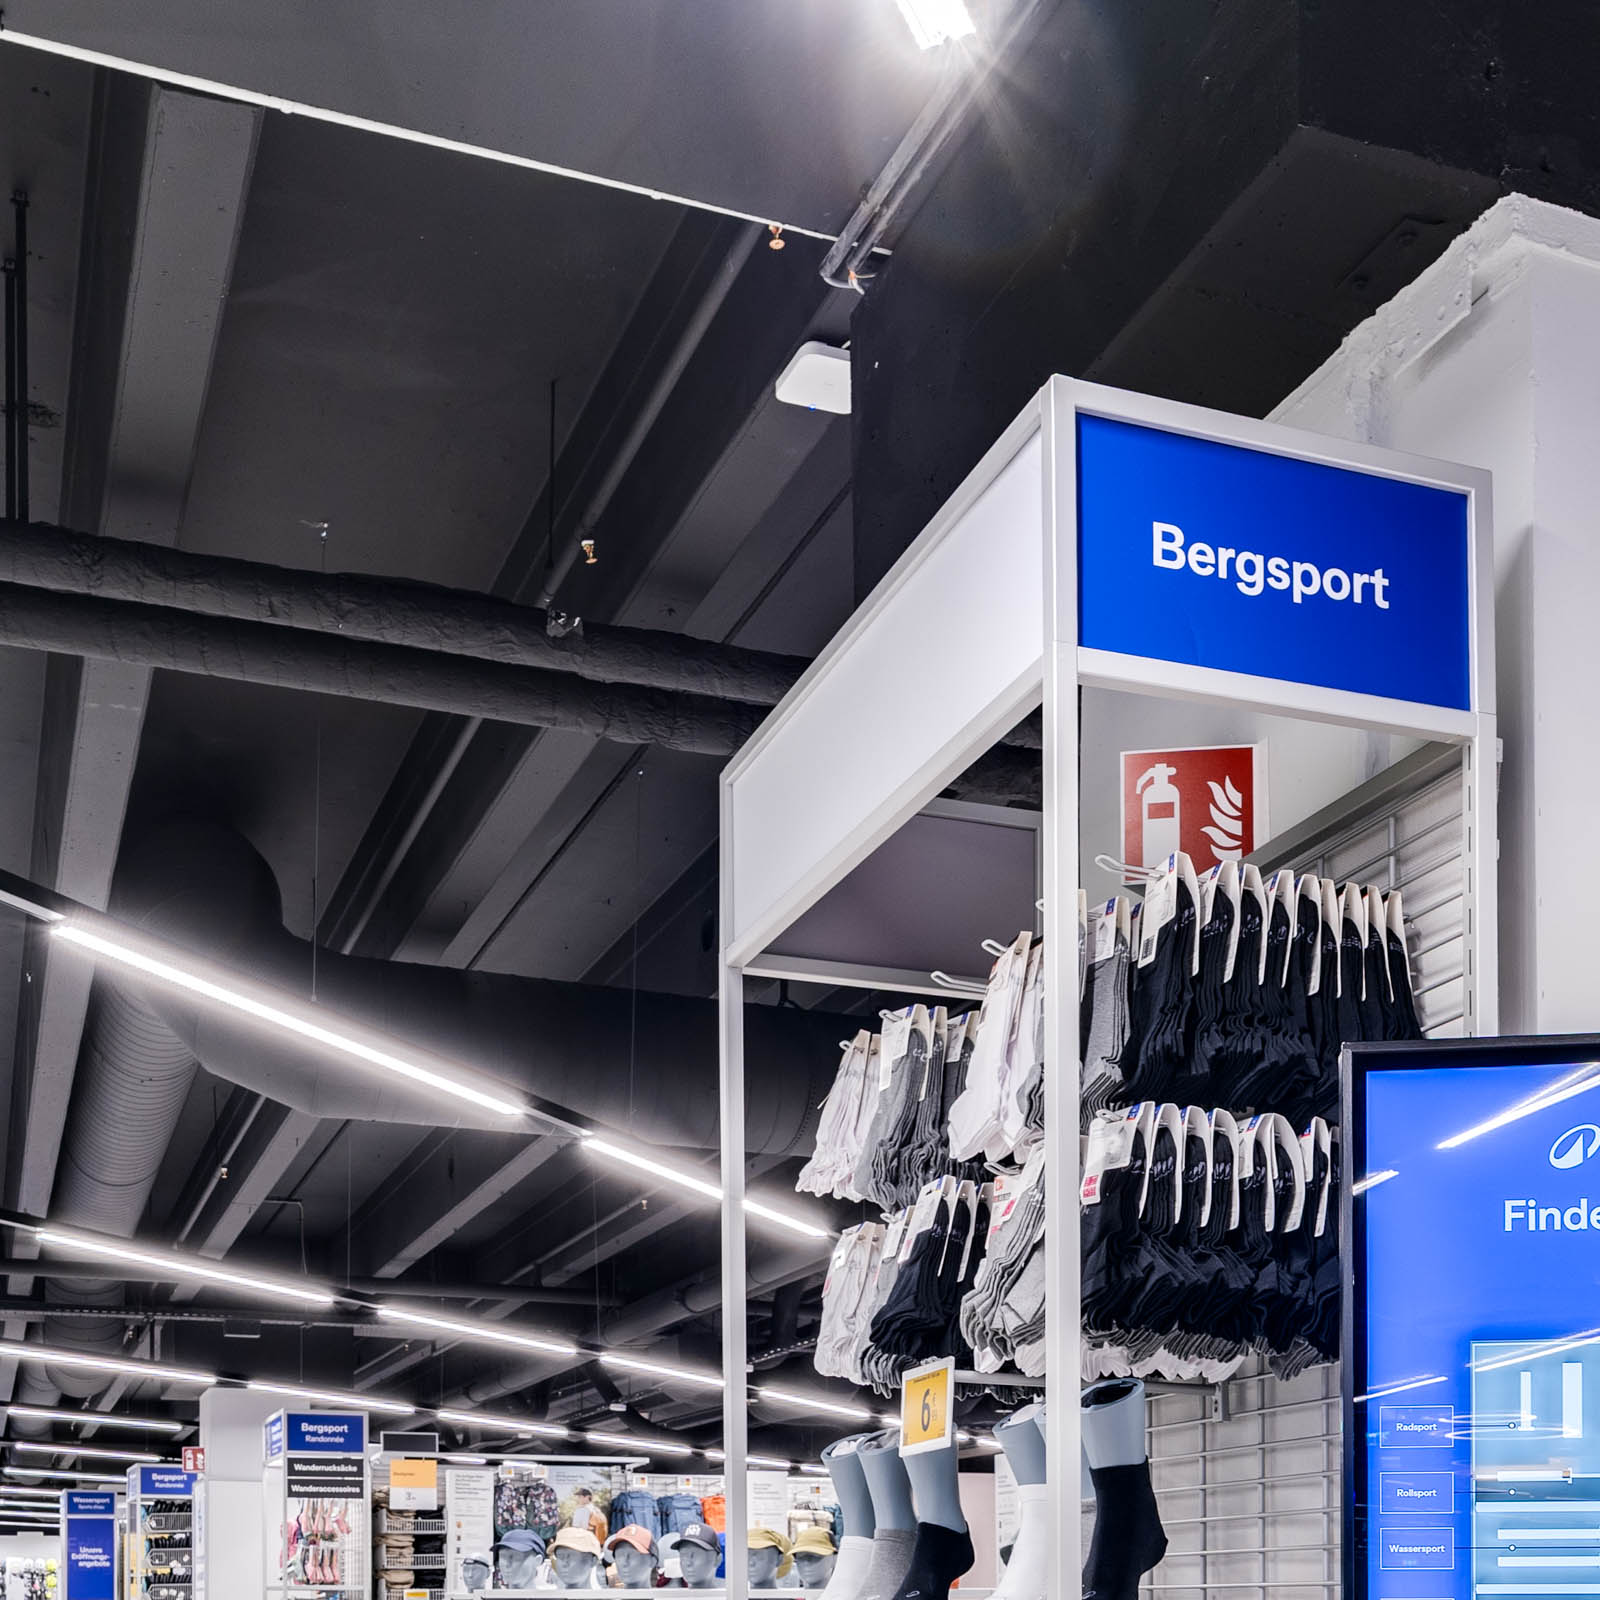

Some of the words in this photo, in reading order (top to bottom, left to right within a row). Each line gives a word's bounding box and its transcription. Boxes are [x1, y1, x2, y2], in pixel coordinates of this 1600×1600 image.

[1153, 521, 1390, 609] Bergsport
[301, 1422, 348, 1434] Bergsport
[1396, 1422, 1438, 1433] Radsport
[1396, 1488, 1437, 1499] Rollsport
[1389, 1543, 1445, 1554] Wassersport
